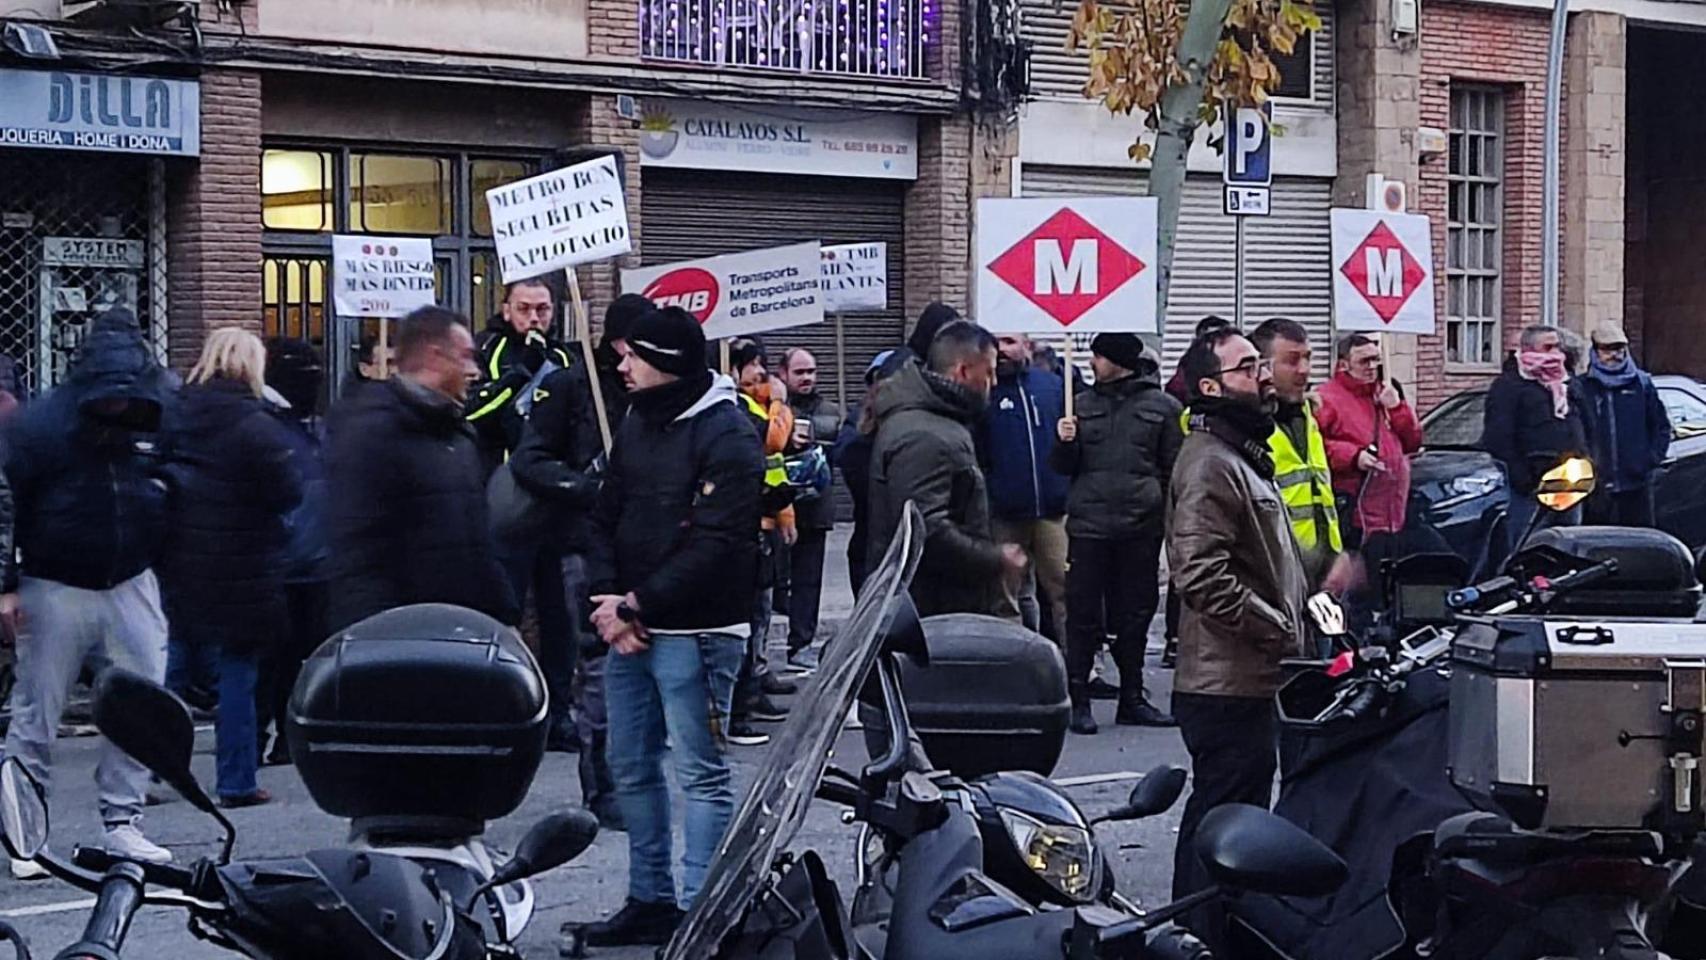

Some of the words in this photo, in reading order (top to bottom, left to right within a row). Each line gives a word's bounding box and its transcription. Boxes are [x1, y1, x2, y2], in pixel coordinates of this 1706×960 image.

[74, 132, 117, 148] HOME
[130, 136, 171, 150] DONA
[685, 118, 778, 142] CATALAYOS
[1236, 107, 1264, 173] P
[494, 178, 566, 207] METRO
[573, 164, 615, 189] BCN
[496, 194, 614, 239] SECURITAS
[62, 240, 127, 254] SYSTEM
[728, 265, 799, 286] Transports
[1034, 238, 1099, 295] M
[1365, 246, 1404, 297] M
[652, 290, 710, 312] TMB
[729, 280, 819, 302] Metropolitans
[730, 305, 747, 318] de
[750, 295, 815, 315] Barcelona
